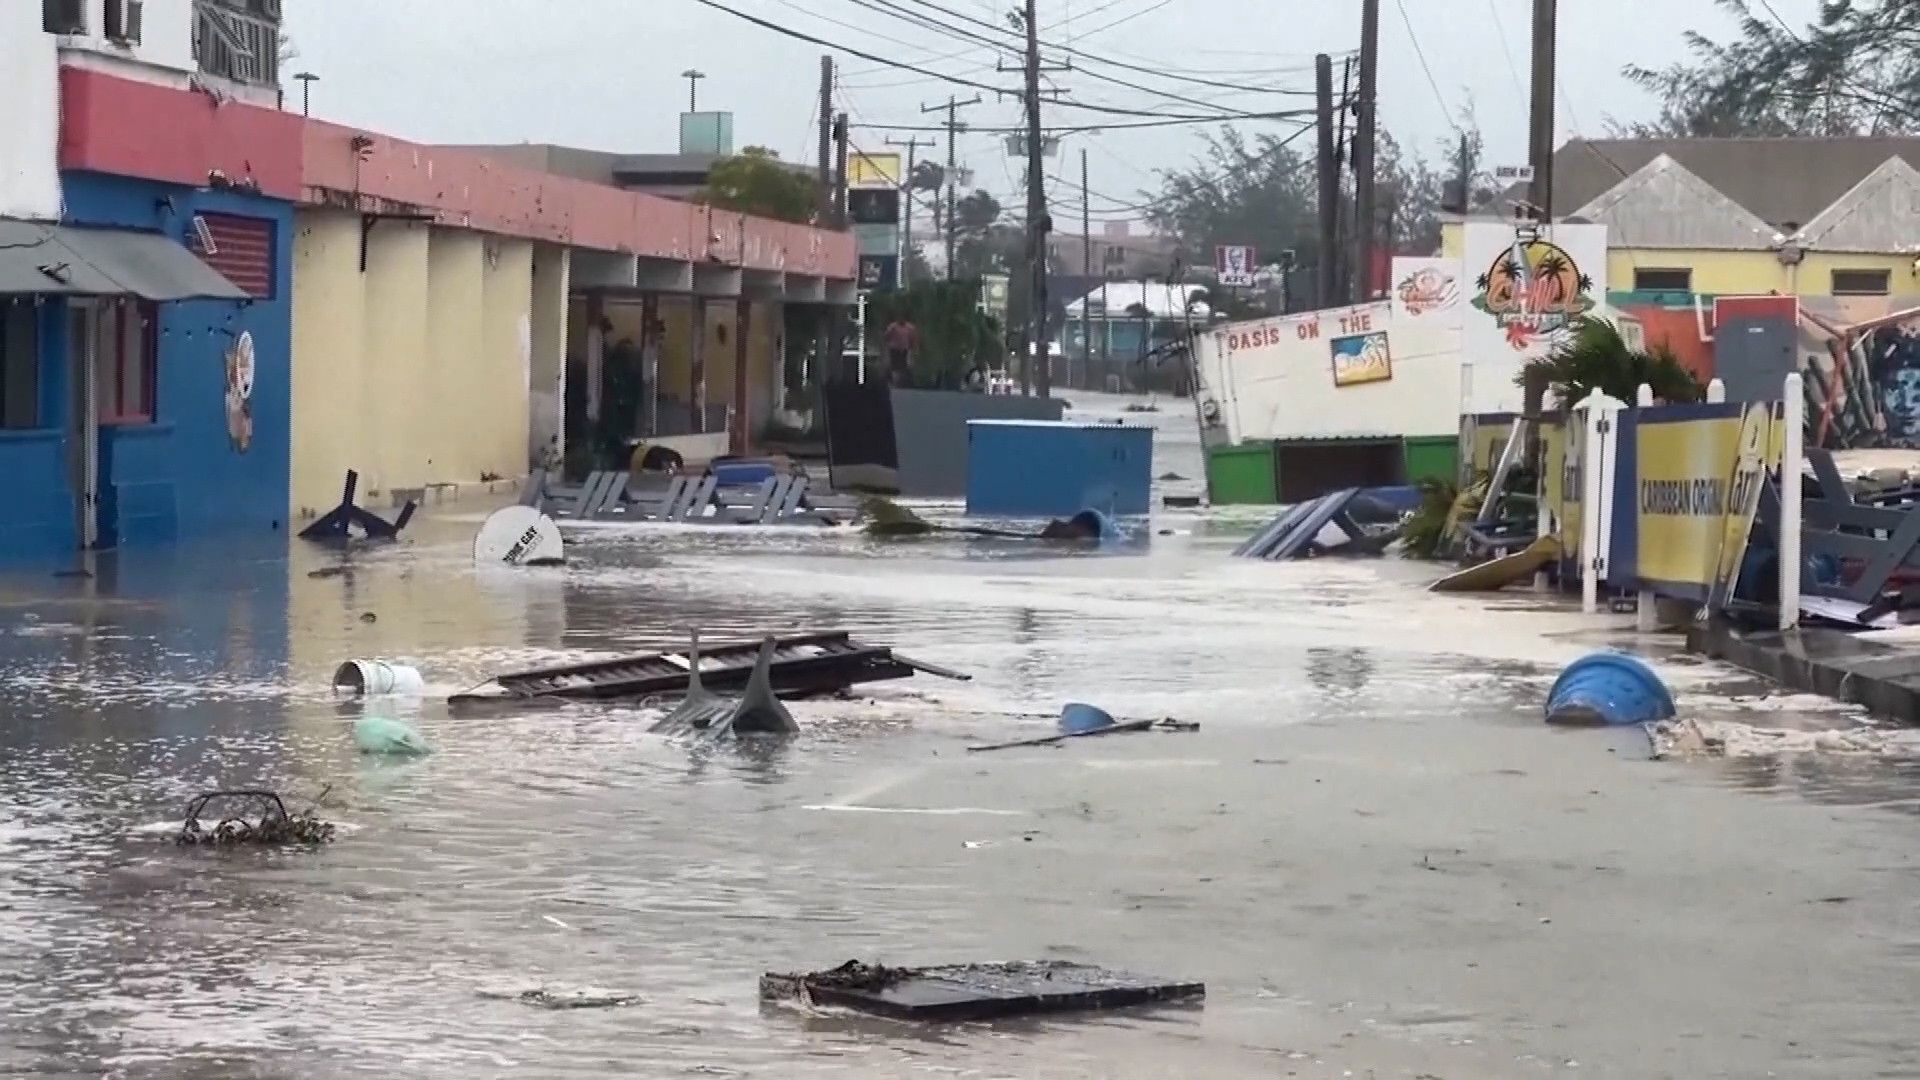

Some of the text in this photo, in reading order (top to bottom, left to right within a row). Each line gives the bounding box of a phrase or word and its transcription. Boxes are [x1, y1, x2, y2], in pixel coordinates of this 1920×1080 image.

[1228, 314, 1372, 350] OASIS ON THE
[1641, 478, 1691, 516] CARIBBEAN
[520, 525, 538, 545] GAY
